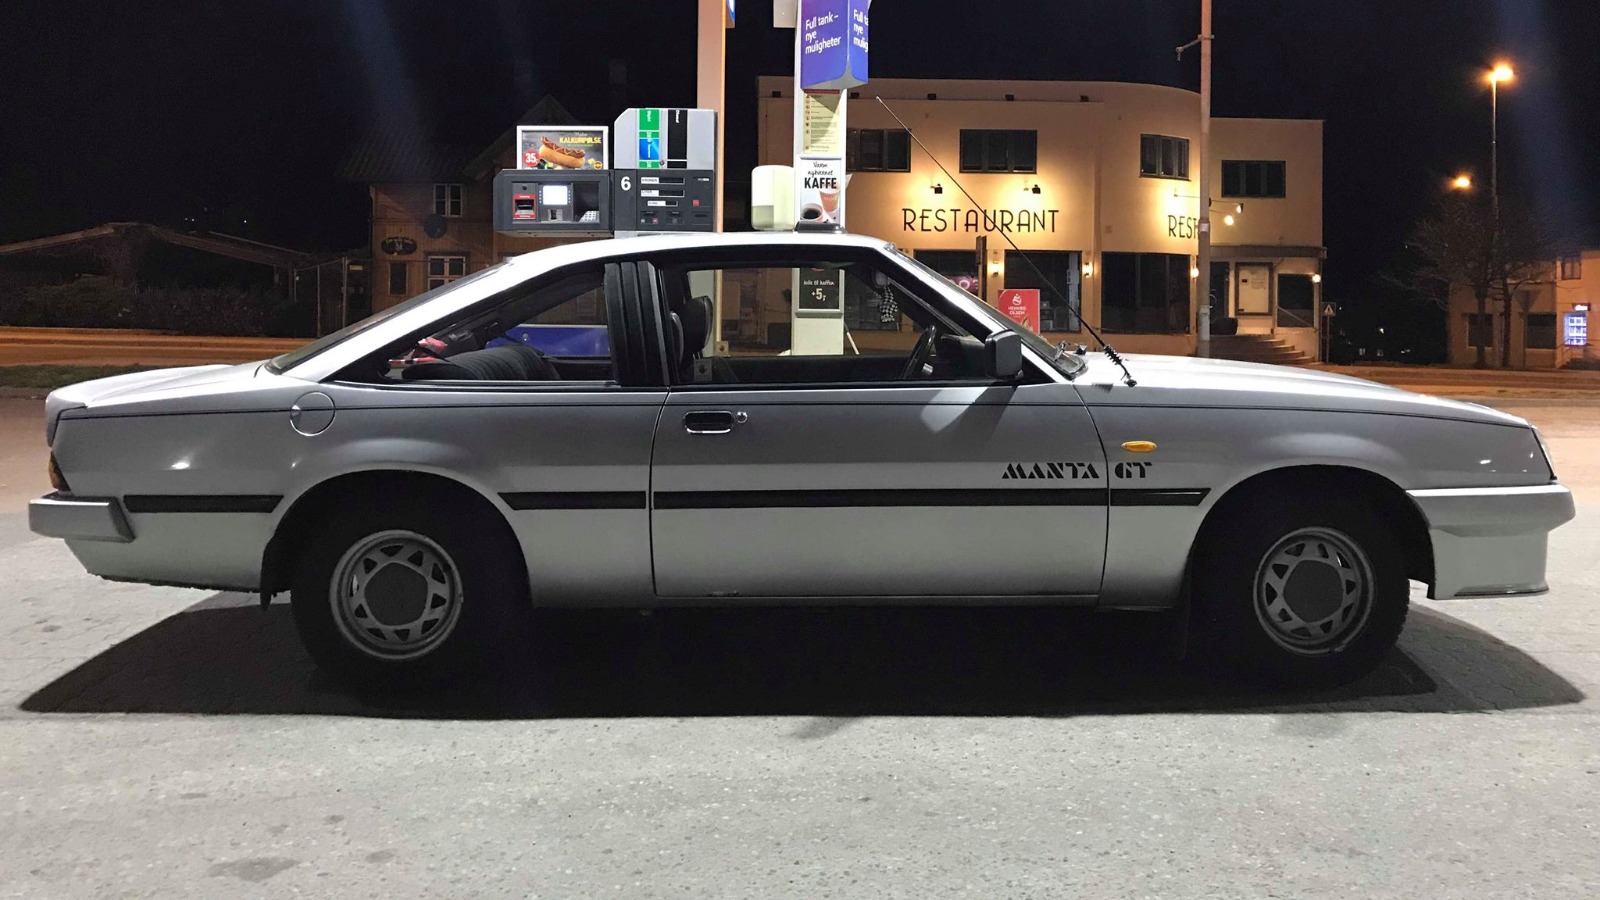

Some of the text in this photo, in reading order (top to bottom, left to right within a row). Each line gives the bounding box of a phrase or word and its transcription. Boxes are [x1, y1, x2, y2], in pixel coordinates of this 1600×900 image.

[805, 16, 817, 31] Full
[853, 8, 863, 24] Full
[805, 30, 817, 44] nye
[853, 23, 864, 36] nye
[805, 36, 841, 55] muligheter
[620, 176, 632, 191] 6
[804, 177, 837, 189] KAFFE
[901, 208, 1060, 233] RESTAURANT
[1167, 214, 1199, 239] REST
[1001, 461, 1153, 479] MANTA GT
